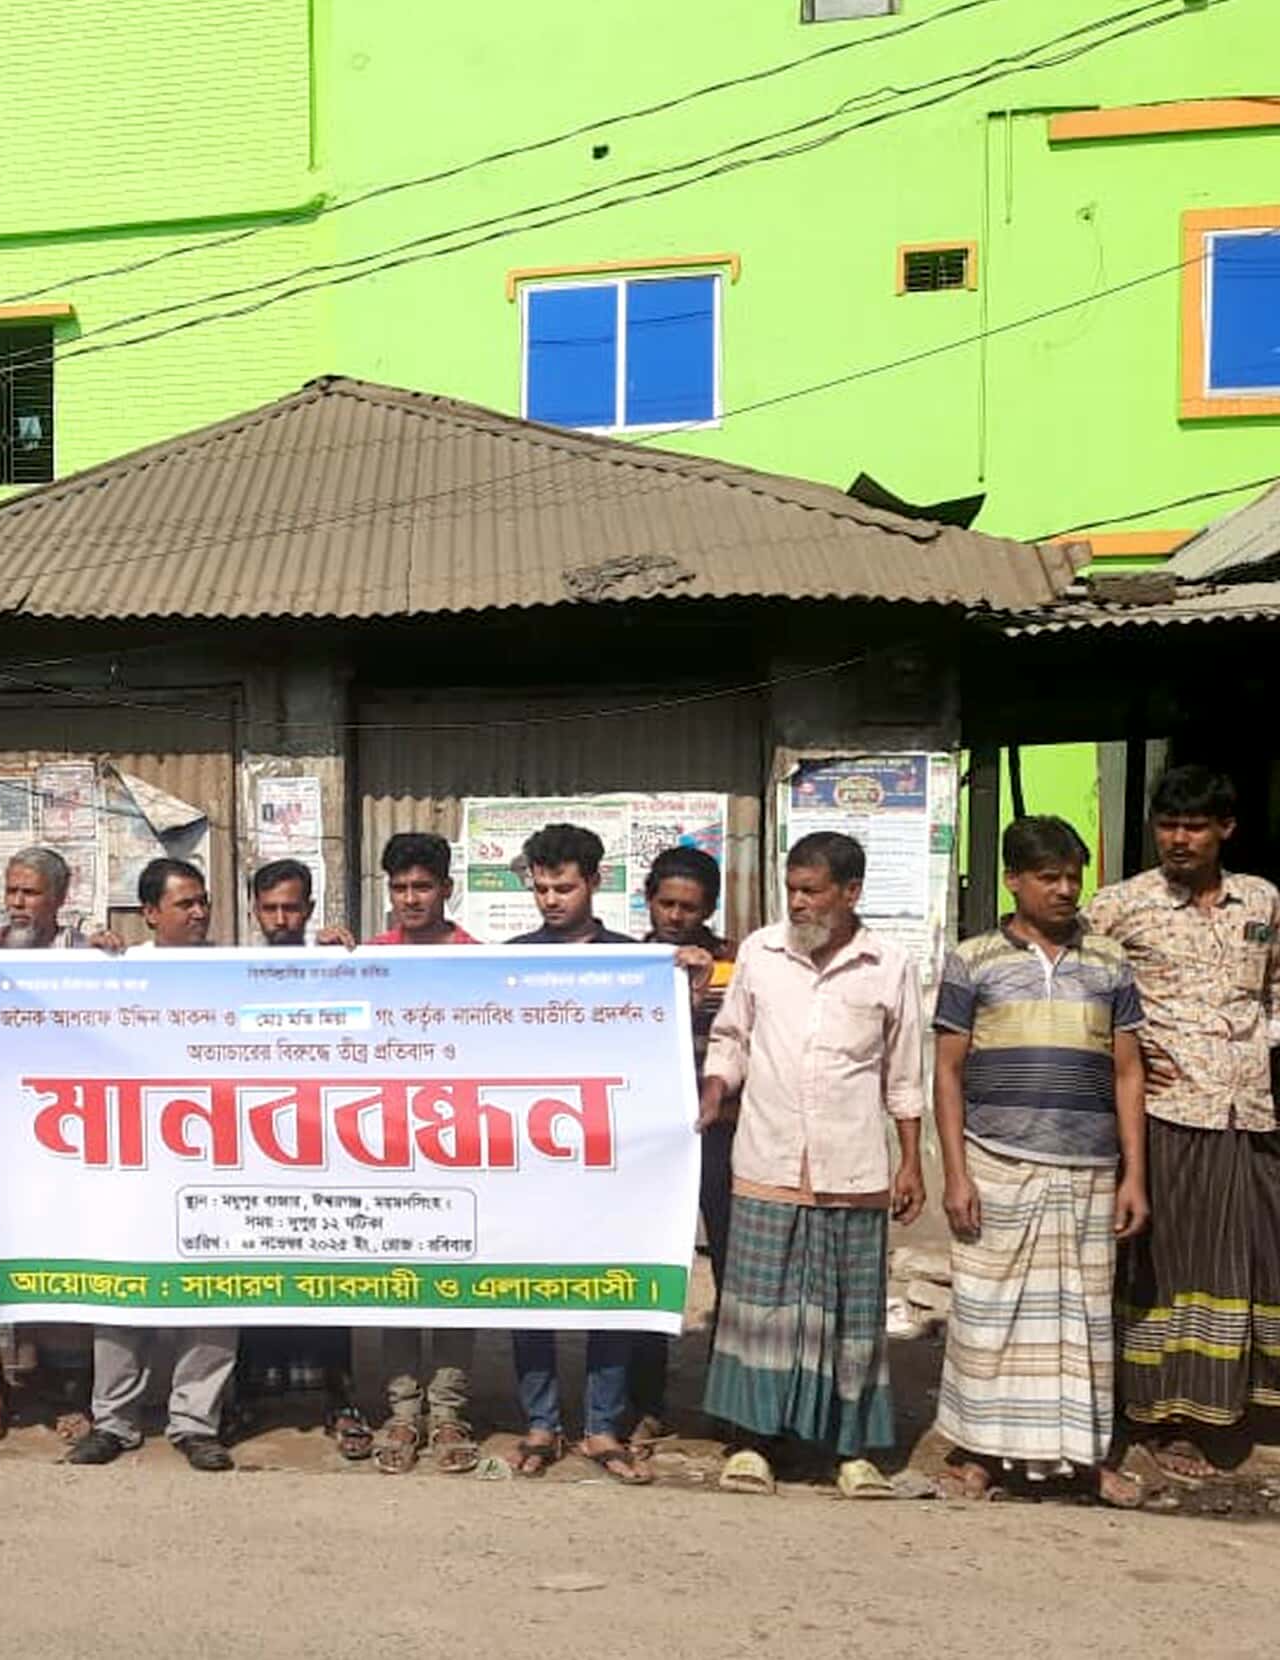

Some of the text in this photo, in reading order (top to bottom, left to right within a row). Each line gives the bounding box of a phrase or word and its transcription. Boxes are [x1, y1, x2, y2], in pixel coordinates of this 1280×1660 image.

[374, 1037, 436, 1063] প্রতিবাদ
[22, 1075, 630, 1173] মানববন্ধন
[9, 1272, 150, 1297] আয়োজনে
[179, 1274, 285, 1299] সাধারণ
[293, 1268, 422, 1302] ব্যাবসায়ী
[433, 1279, 460, 1299] ও
[472, 1269, 640, 1302] এলাকাবাসী
